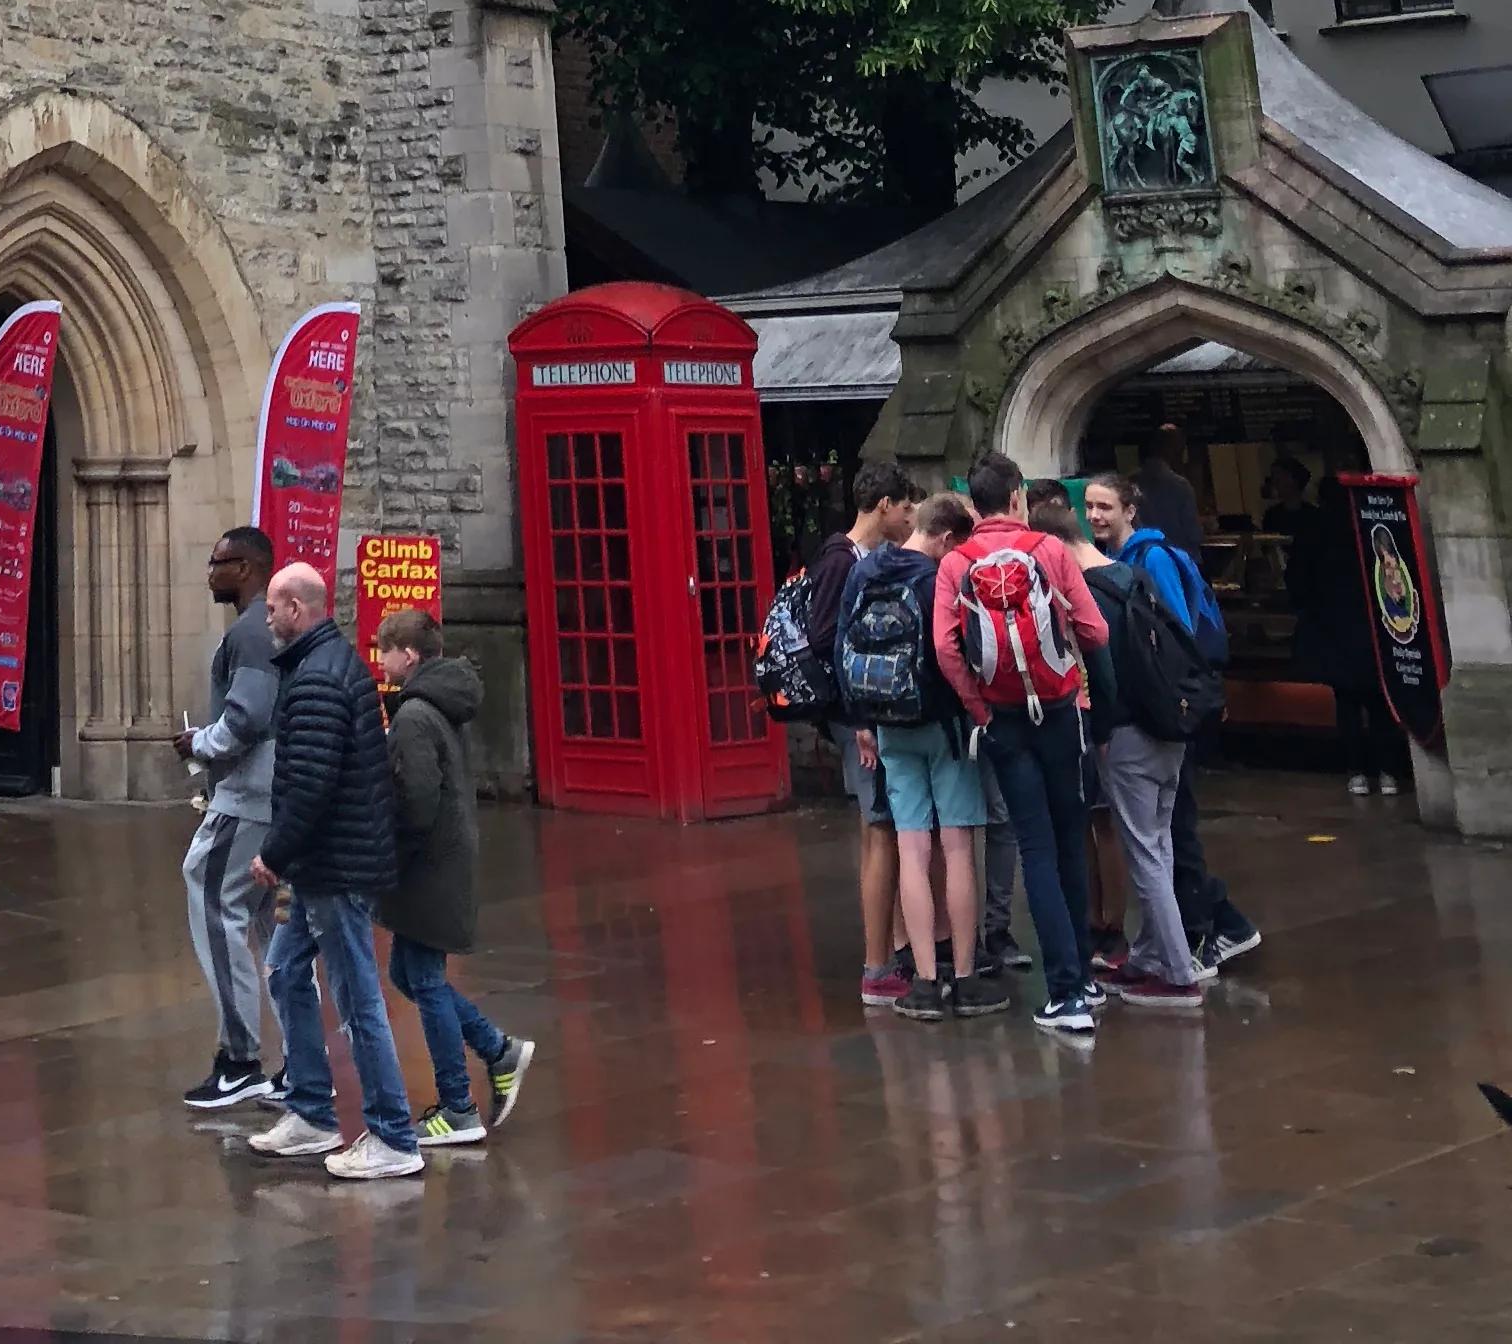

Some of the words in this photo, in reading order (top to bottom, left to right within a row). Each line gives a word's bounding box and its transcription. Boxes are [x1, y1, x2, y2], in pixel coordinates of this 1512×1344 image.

[13, 353, 46, 377] HERE
[309, 350, 345, 371] HERE
[538, 363, 634, 384] TELEPHONE
[667, 363, 739, 383] TELEPHONE
[289, 386, 342, 414] Oxford
[289, 500, 300, 513] 20
[366, 539, 433, 560] Climb
[360, 559, 438, 580] Carfax
[363, 579, 437, 600] Tower
